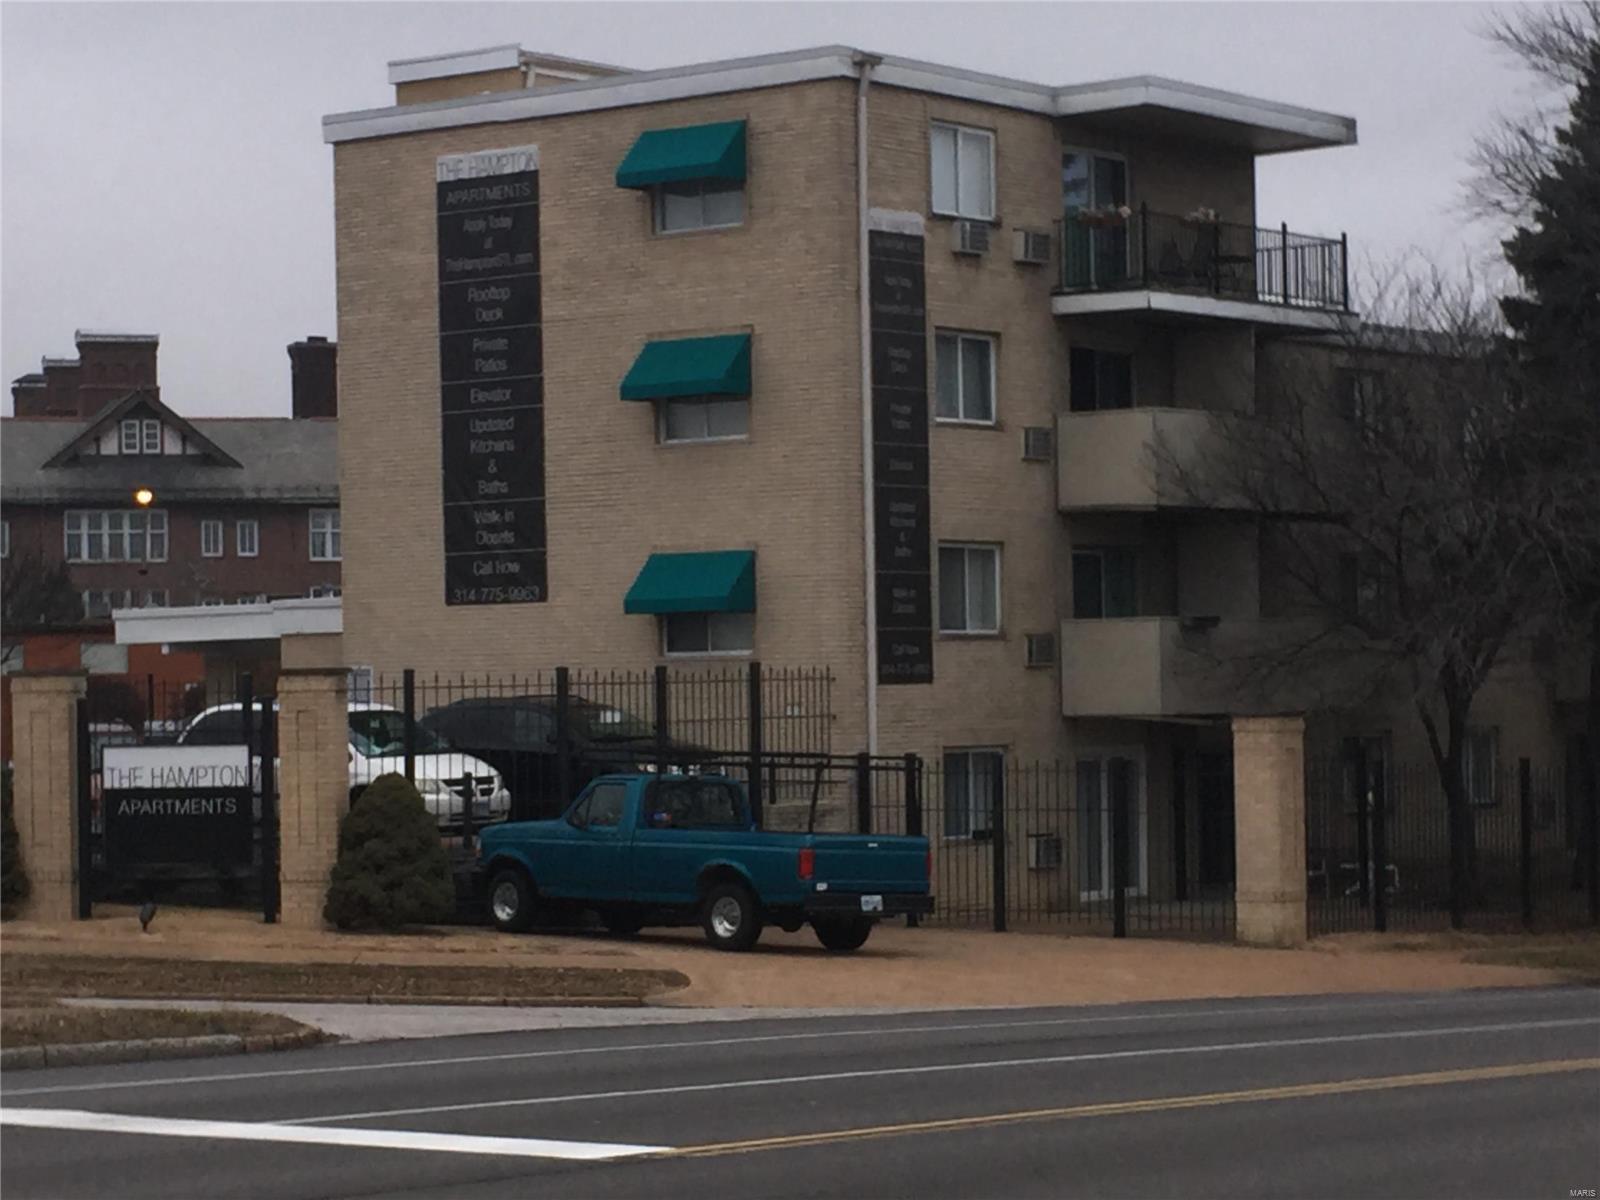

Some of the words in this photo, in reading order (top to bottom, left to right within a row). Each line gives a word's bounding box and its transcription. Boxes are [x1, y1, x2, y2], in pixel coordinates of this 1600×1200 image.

[439, 159, 465, 180] THE
[469, 151, 537, 177] HAMPTON
[446, 182, 531, 206] APARTMENTS
[467, 286, 511, 303] Rooftop
[475, 307, 504, 323] Deck
[475, 357, 508, 373] Patios
[470, 386, 513, 404] Elevator
[469, 416, 515, 435] Updated
[469, 439, 515, 454] Kitchens
[487, 458, 498, 474] &
[477, 479, 509, 495] Baths
[475, 529, 515, 545] Closets
[473, 559, 494, 577] Call
[495, 559, 521, 574] Now
[453, 588, 476, 604] 314
[107, 766, 144, 788] THE
[150, 764, 249, 788] HAMPTON
[118, 796, 238, 815] APARTMENTS
